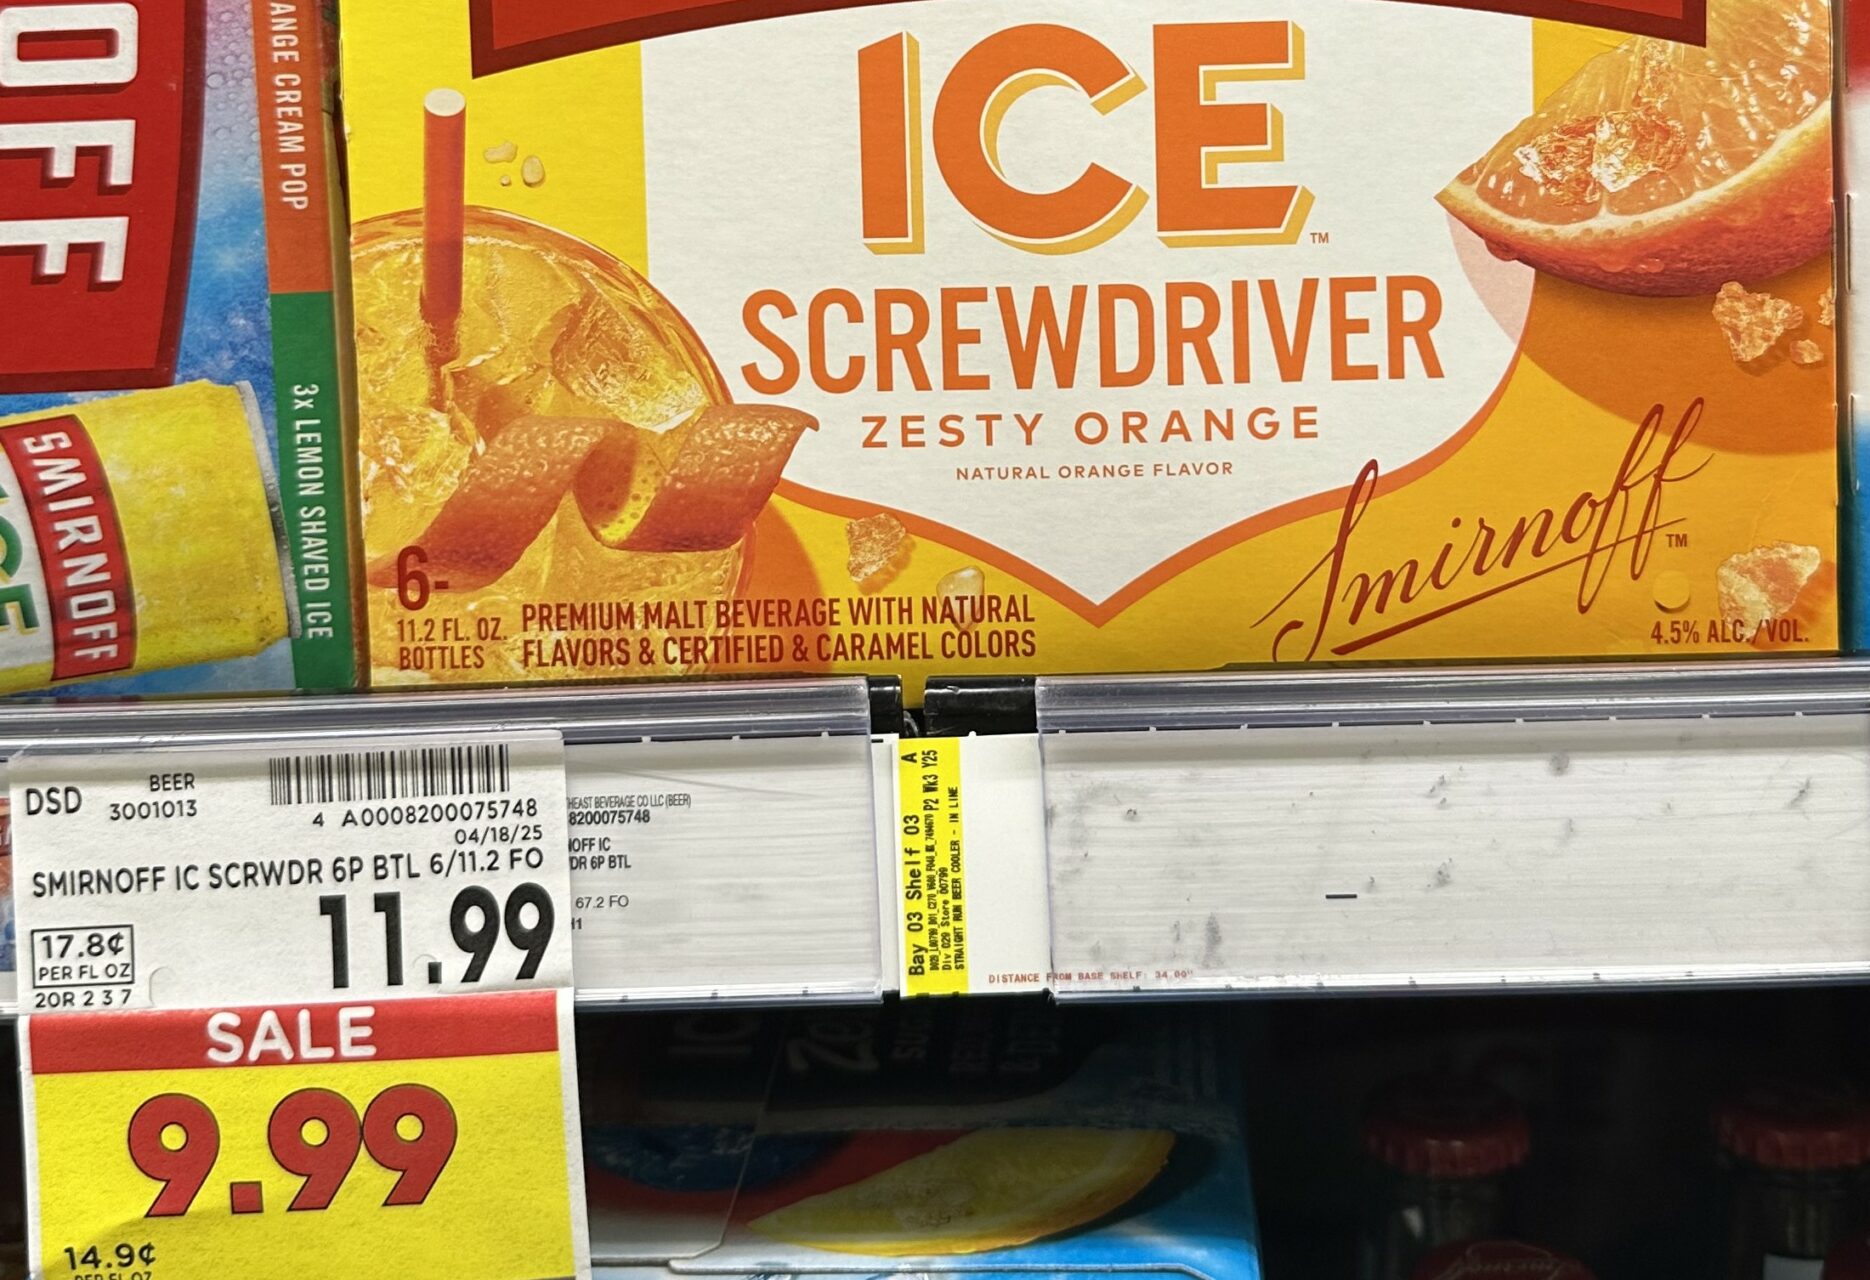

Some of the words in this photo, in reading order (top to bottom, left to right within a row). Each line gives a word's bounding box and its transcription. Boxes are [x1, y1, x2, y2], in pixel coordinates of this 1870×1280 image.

[273, 72, 306, 158] CREAM
[857, 20, 1316, 256] ICE
[281, 163, 309, 212] POP
[741, 275, 1446, 395] SCREWDRIVER
[293, 383, 319, 409] 3x
[862, 414, 1044, 449] ZESTY
[1073, 405, 1319, 445] ORANGE
[293, 418, 323, 500] LEMON
[956, 465, 1050, 481] NATURAL
[1057, 463, 1146, 479] ORANGE
[1152, 461, 1234, 477] FLAVOR
[1249, 396, 1716, 662] Smirnoff
[22, 430, 118, 660] SMIRNOFF
[298, 505, 329, 589] SHAVED
[397, 545, 449, 612] 6-
[305, 595, 333, 640] ICE
[521, 600, 637, 633] PREMIUM
[644, 599, 706, 631] MALT
[715, 597, 842, 629] BEVERAGE
[847, 595, 913, 627] WITH
[922, 593, 1036, 625] NATURAL
[397, 619, 437, 643] 11.2
[442, 618, 473, 642] FL.
[478, 616, 508, 641] OZ.
[1649, 620, 1700, 645] 4.5%
[1706, 618, 1810, 645] ALC./VOL.
[399, 645, 485, 671] BOTTLES
[522, 635, 630, 668] FLAVORS
[637, 635, 656, 666] &
[660, 633, 785, 665] CERTIFIED
[793, 631, 810, 662] &
[816, 630, 935, 662] CARAMEL
[940, 628, 1037, 660] COLORS
[901, 751, 917, 764] A
[921, 749, 938, 768] Y25
[149, 773, 195, 792] BEER
[922, 773, 938, 793] Wk3
[25, 786, 83, 815] DSD
[109, 799, 198, 821] 3001013
[594, 794, 636, 809] BEVERAGE
[636, 794, 649, 808] CO
[650, 794, 664, 807] LLC
[665, 793, 692, 808] (BEER)
[923, 798, 939, 811] P2
[948, 786, 959, 808] LINE
[312, 812, 325, 827] 4
[341, 798, 538, 827] A0008200075748
[903, 814, 920, 835] 03
[949, 813, 959, 823] IN
[454, 824, 543, 846] 04/18/25
[599, 837, 611, 851] IC
[569, 856, 588, 870] DR
[590, 856, 605, 869] 6P
[608, 854, 632, 869] BTL
[950, 839, 961, 873] COOLER
[33, 866, 166, 898] SMIRNOFF
[175, 864, 200, 891] IC
[208, 858, 323, 889] SCRWDR
[332, 856, 364, 883] 6P
[373, 852, 421, 880] BTL
[429, 849, 500, 878] 6/11.2
[509, 847, 544, 870] FO
[904, 847, 922, 900] Shelf
[575, 896, 605, 909] 67.2
[609, 894, 630, 908] FO
[951, 877, 962, 900] BEER
[907, 912, 924, 932] 03
[940, 899, 950, 927] Store
[952, 904, 963, 922] RUN
[41, 931, 125, 959] 17.8¢
[319, 881, 556, 989] 11.99
[941, 931, 951, 948] 029
[953, 926, 965, 970] STRAIGHT
[38, 965, 73, 981] PER
[78, 964, 99, 979] FL
[104, 962, 132, 978] OZ
[908, 943, 928, 976] Bay
[942, 952, 952, 971] Div
[988, 972, 1040, 984] DISTANCE
[1046, 971, 1073, 983] FROM
[1077, 970, 1104, 982] BASE
[83, 990, 95, 1007] 2
[102, 989, 113, 1006] 3
[121, 988, 132, 1004] 7
[205, 1005, 377, 1064] SALE
[127, 1082, 459, 1218] 9.99
[63, 1241, 157, 1271] 14.9¢
